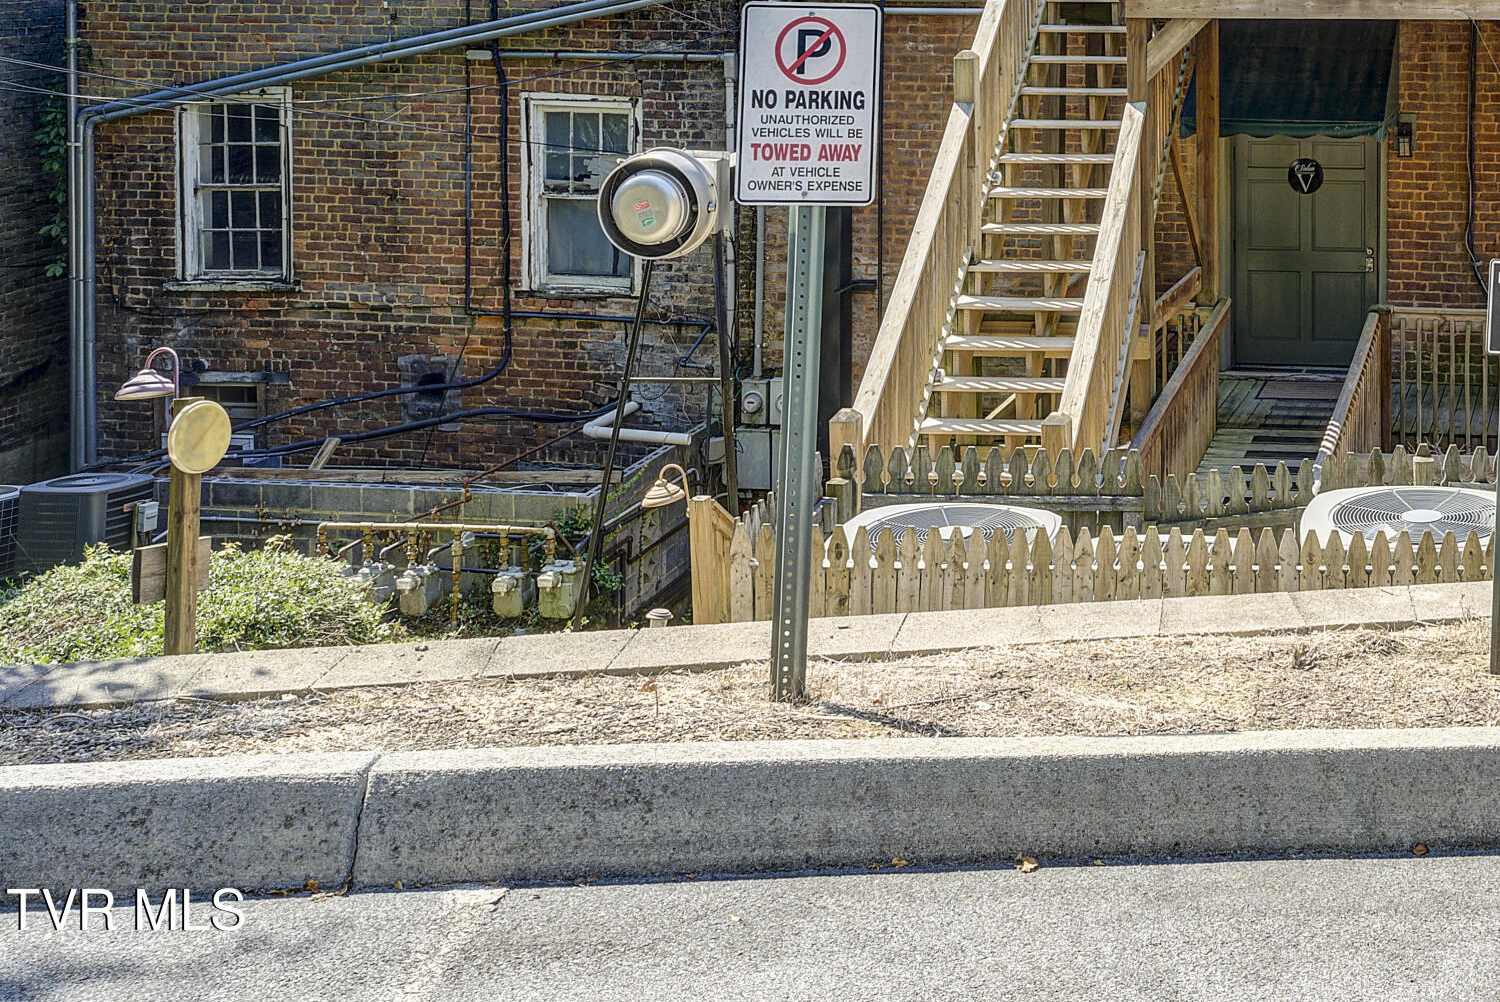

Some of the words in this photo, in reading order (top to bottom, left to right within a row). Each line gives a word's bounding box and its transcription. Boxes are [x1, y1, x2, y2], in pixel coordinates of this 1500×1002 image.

[751, 89, 777, 109] NO
[785, 90, 865, 110] PARKING
[760, 114, 855, 125] UNAUTHORIZED
[752, 127, 811, 138] VEHICLES
[815, 128, 843, 138] WILL
[847, 128, 863, 139] BE
[750, 143, 811, 161] TOWED
[817, 144, 862, 162] AWAY
[771, 166, 785, 177] AT
[789, 167, 840, 177] VEHICLE
[747, 180, 803, 191] OWNER'S
[807, 180, 863, 191] EXPENSE
[1297, 173, 1314, 193] V
